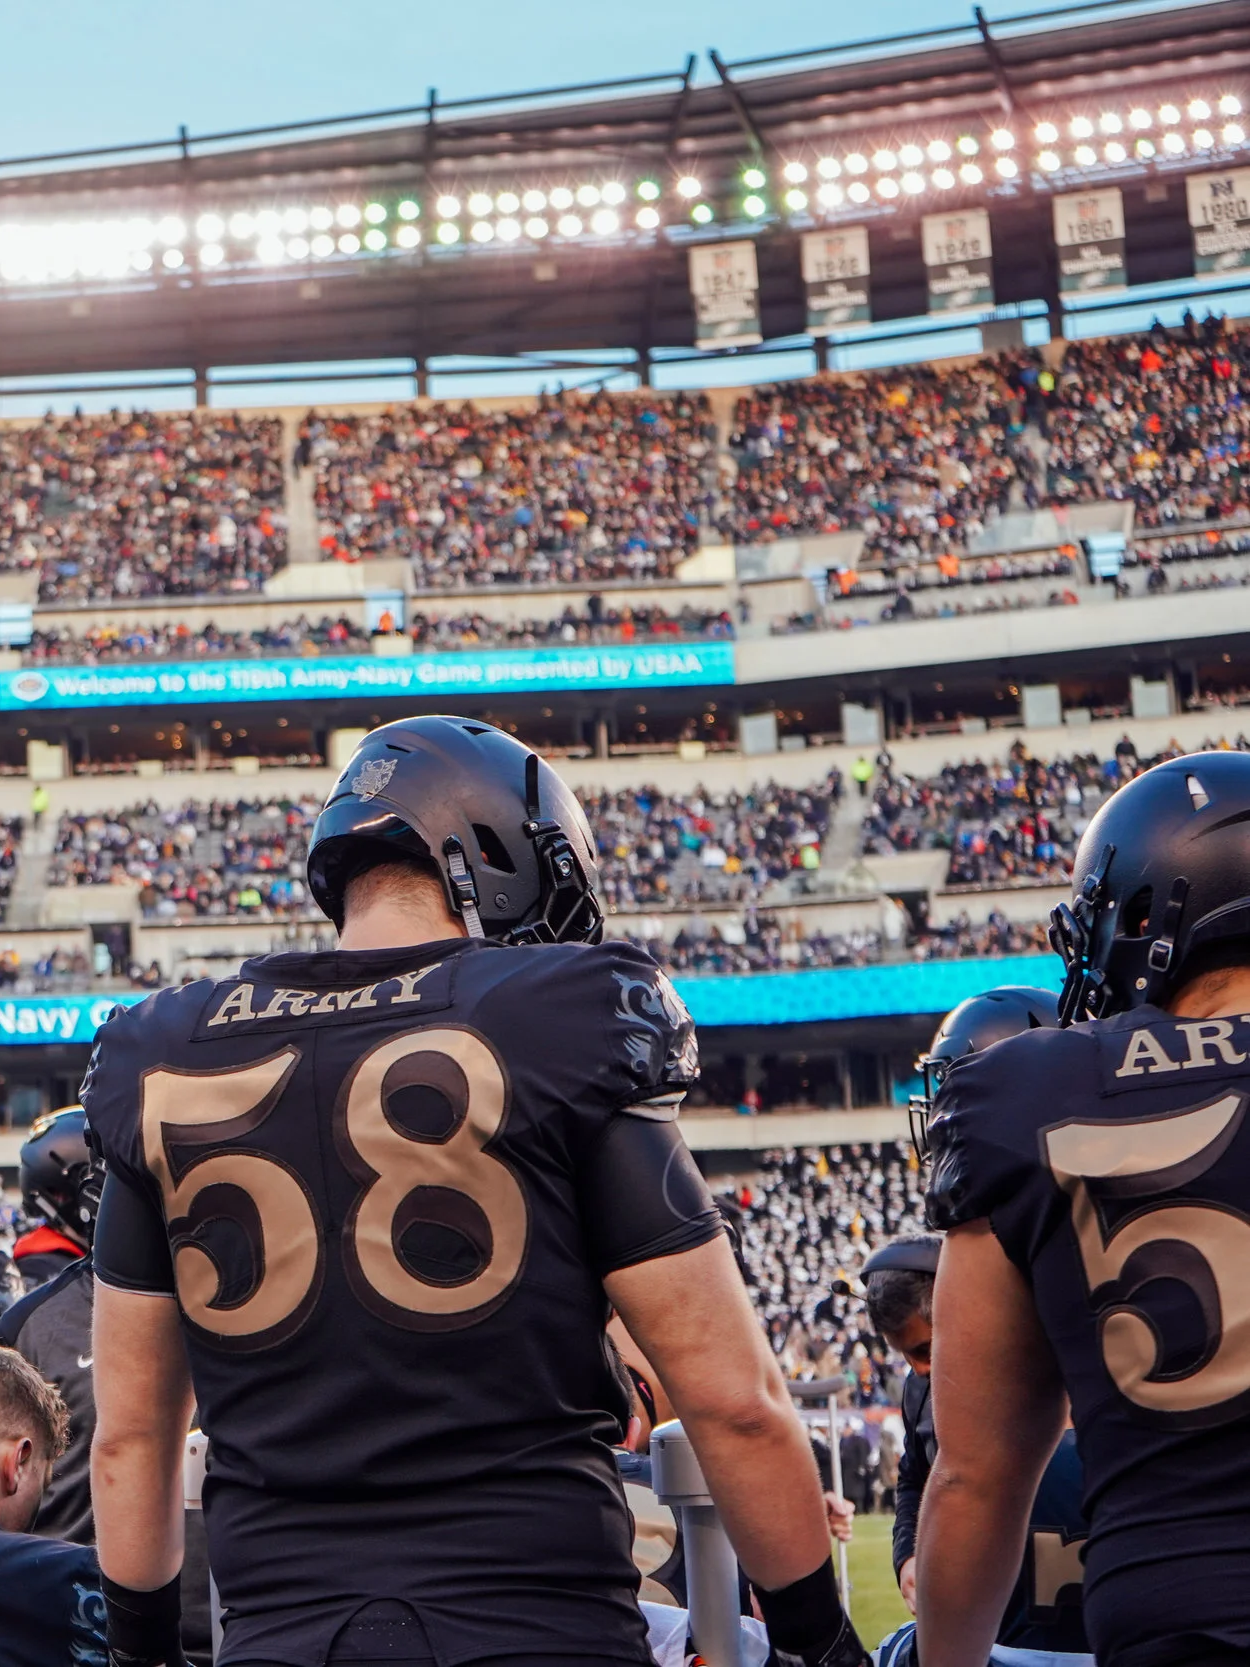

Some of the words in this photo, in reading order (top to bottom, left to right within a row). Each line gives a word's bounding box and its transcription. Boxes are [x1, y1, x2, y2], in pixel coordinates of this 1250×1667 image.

[53, 673, 157, 696] Welcome
[158, 673, 186, 693] to
[188, 669, 226, 692] the
[290, 663, 414, 690] Army-Navy
[415, 660, 483, 684] Game
[484, 656, 599, 684] presented
[601, 655, 632, 680] by
[207, 962, 443, 1028] ARMY
[1115, 1014, 1250, 1078] AR
[140, 1023, 530, 1349] 58
